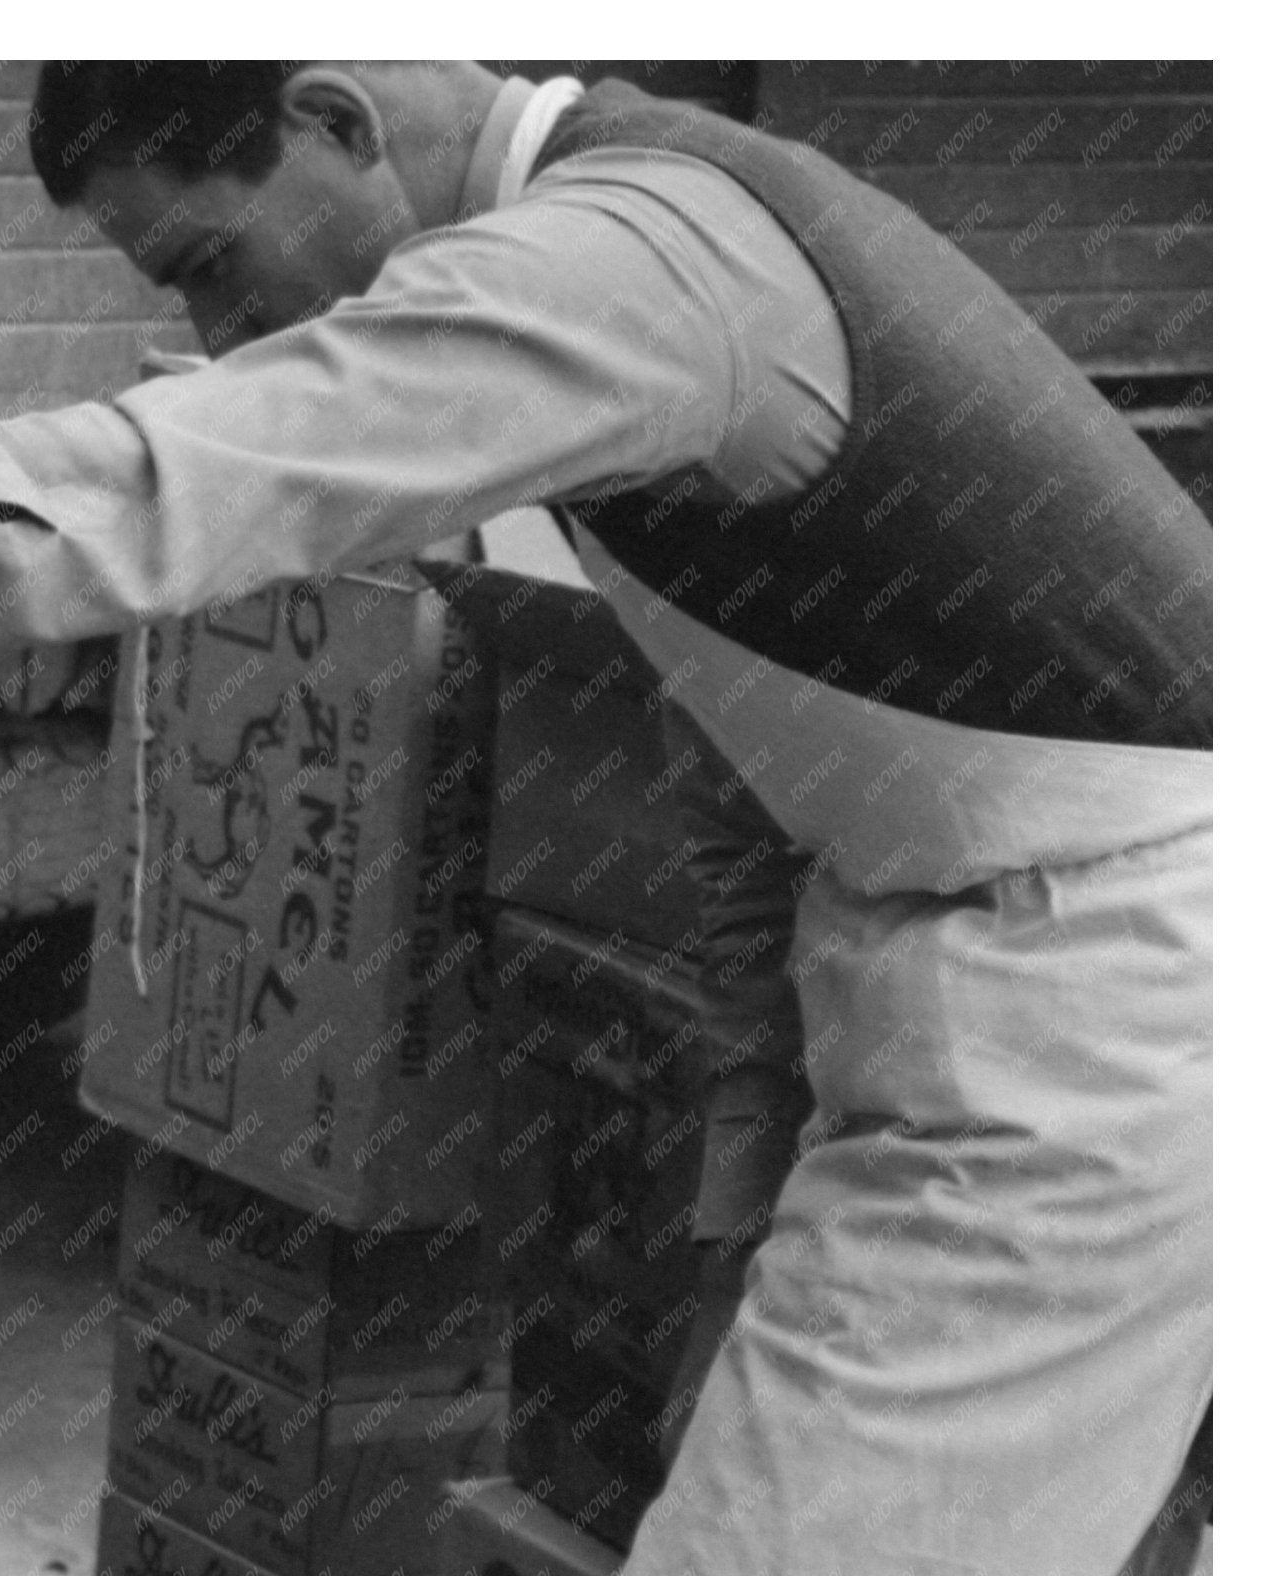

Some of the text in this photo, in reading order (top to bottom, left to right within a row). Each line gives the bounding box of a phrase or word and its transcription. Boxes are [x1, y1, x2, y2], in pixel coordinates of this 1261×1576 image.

[252, 577, 341, 1037] CAMEL
[328, 759, 368, 963] CARTONS
[416, 714, 461, 917] CARTONS
[134, 1340, 278, 1467] Duke's
